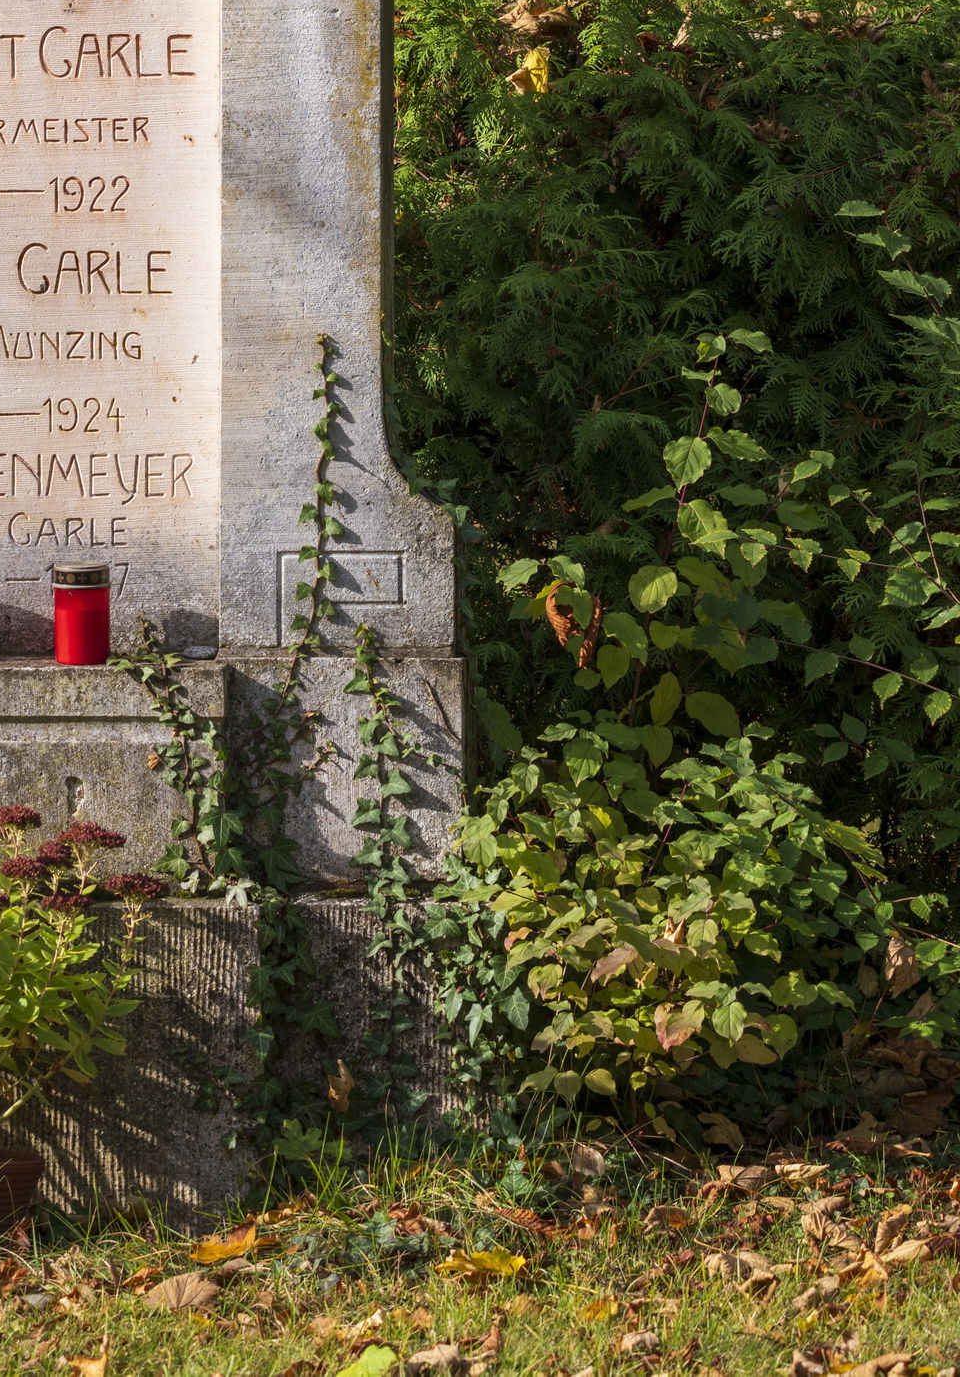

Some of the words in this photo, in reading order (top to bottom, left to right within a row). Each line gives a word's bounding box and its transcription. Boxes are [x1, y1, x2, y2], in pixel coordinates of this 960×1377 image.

[38, 26, 197, 80] CARLE
[16, 242, 173, 296] CARLE
[7, 511, 130, 549] CARLE
